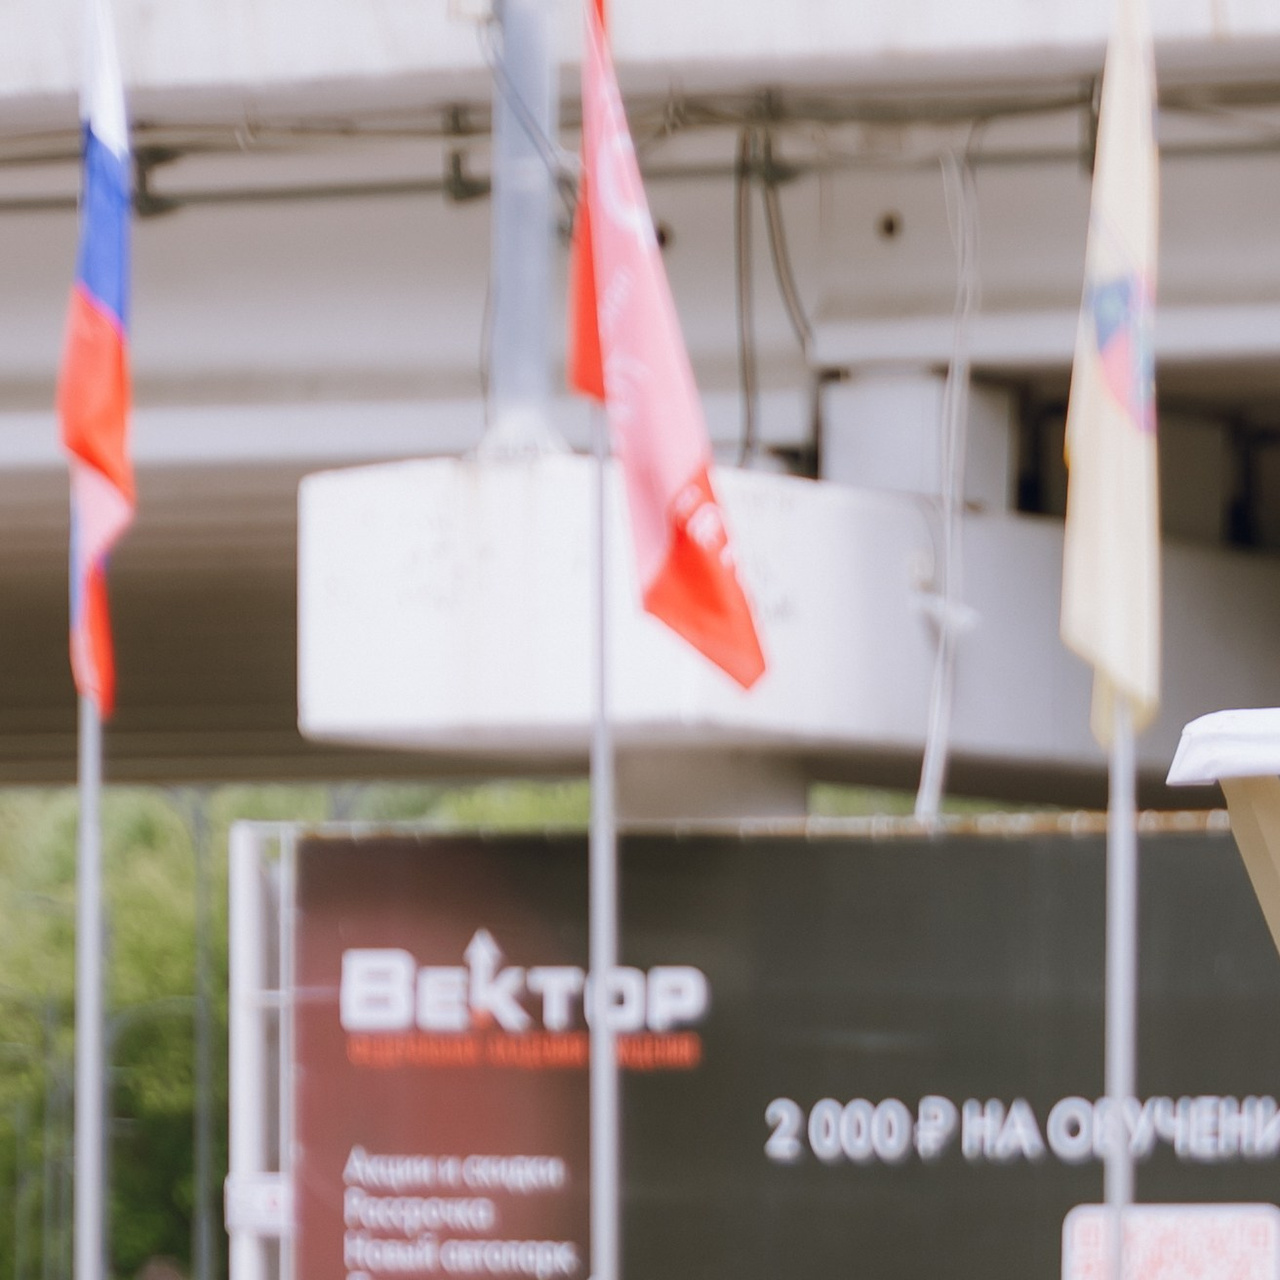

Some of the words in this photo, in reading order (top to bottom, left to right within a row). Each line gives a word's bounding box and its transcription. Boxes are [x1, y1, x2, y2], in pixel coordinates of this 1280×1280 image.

[763, 1096, 803, 1163] 2
[807, 1096, 914, 1163] 000
[961, 1095, 1047, 1162] НА
